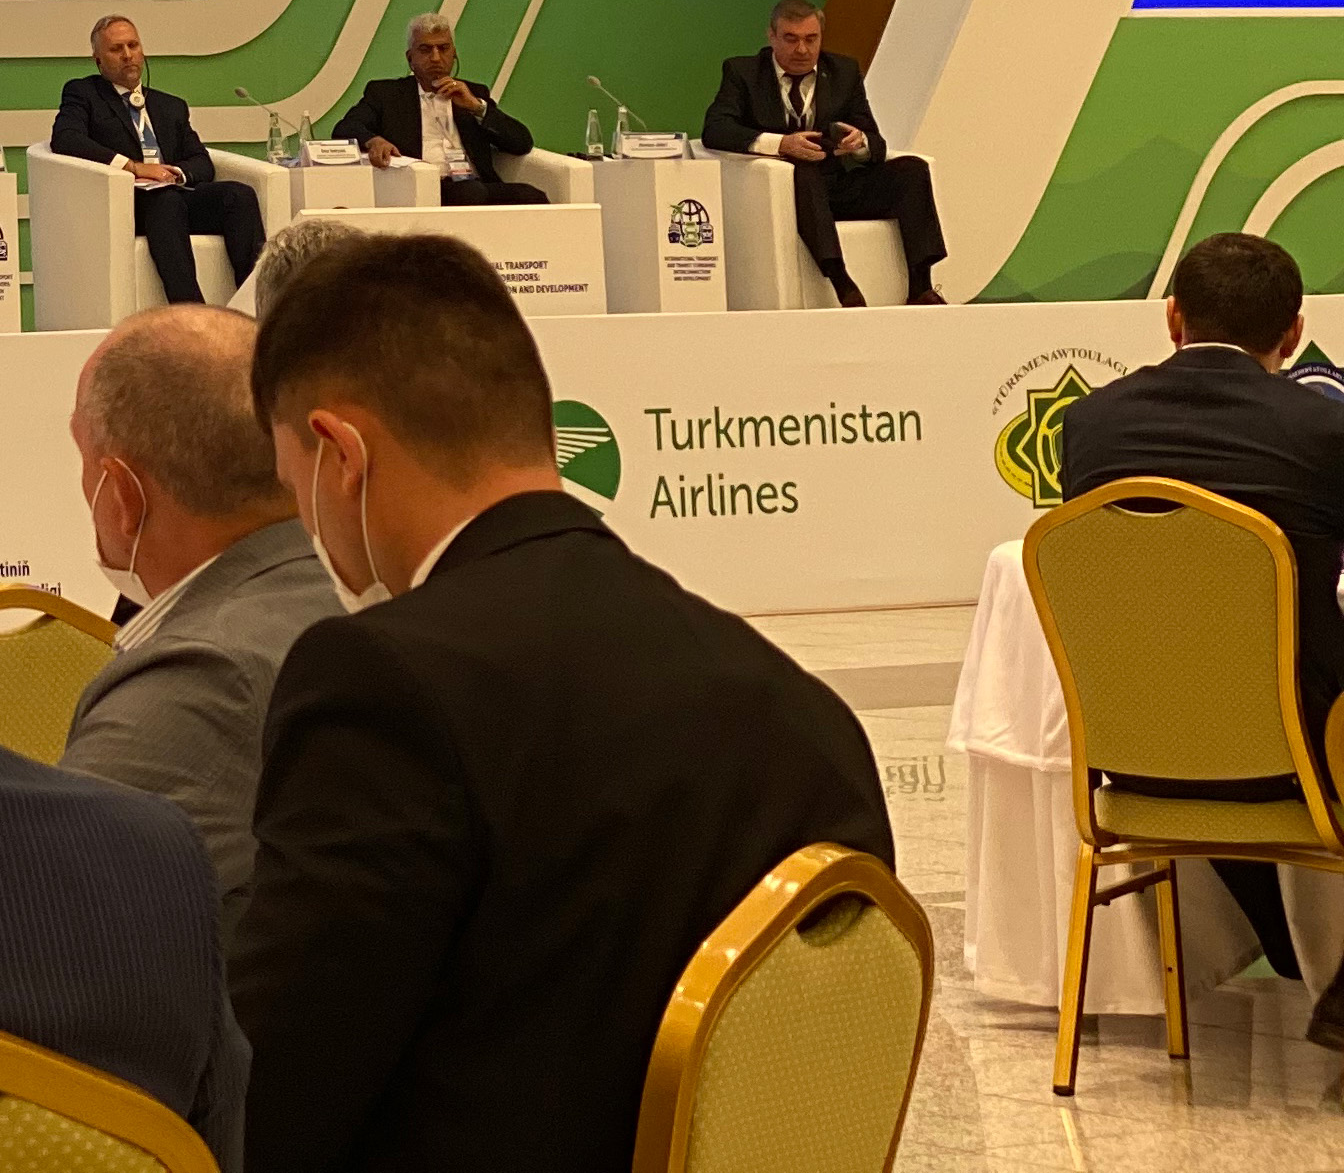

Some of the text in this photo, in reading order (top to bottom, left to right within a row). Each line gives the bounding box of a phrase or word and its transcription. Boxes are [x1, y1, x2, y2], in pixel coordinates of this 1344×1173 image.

[505, 260, 548, 270] TRANSPORT
[519, 285, 534, 294] AND
[536, 283, 589, 294] DEVELOPMENT
[644, 401, 922, 451] Turkmenistan
[650, 472, 799, 518] Airlines
